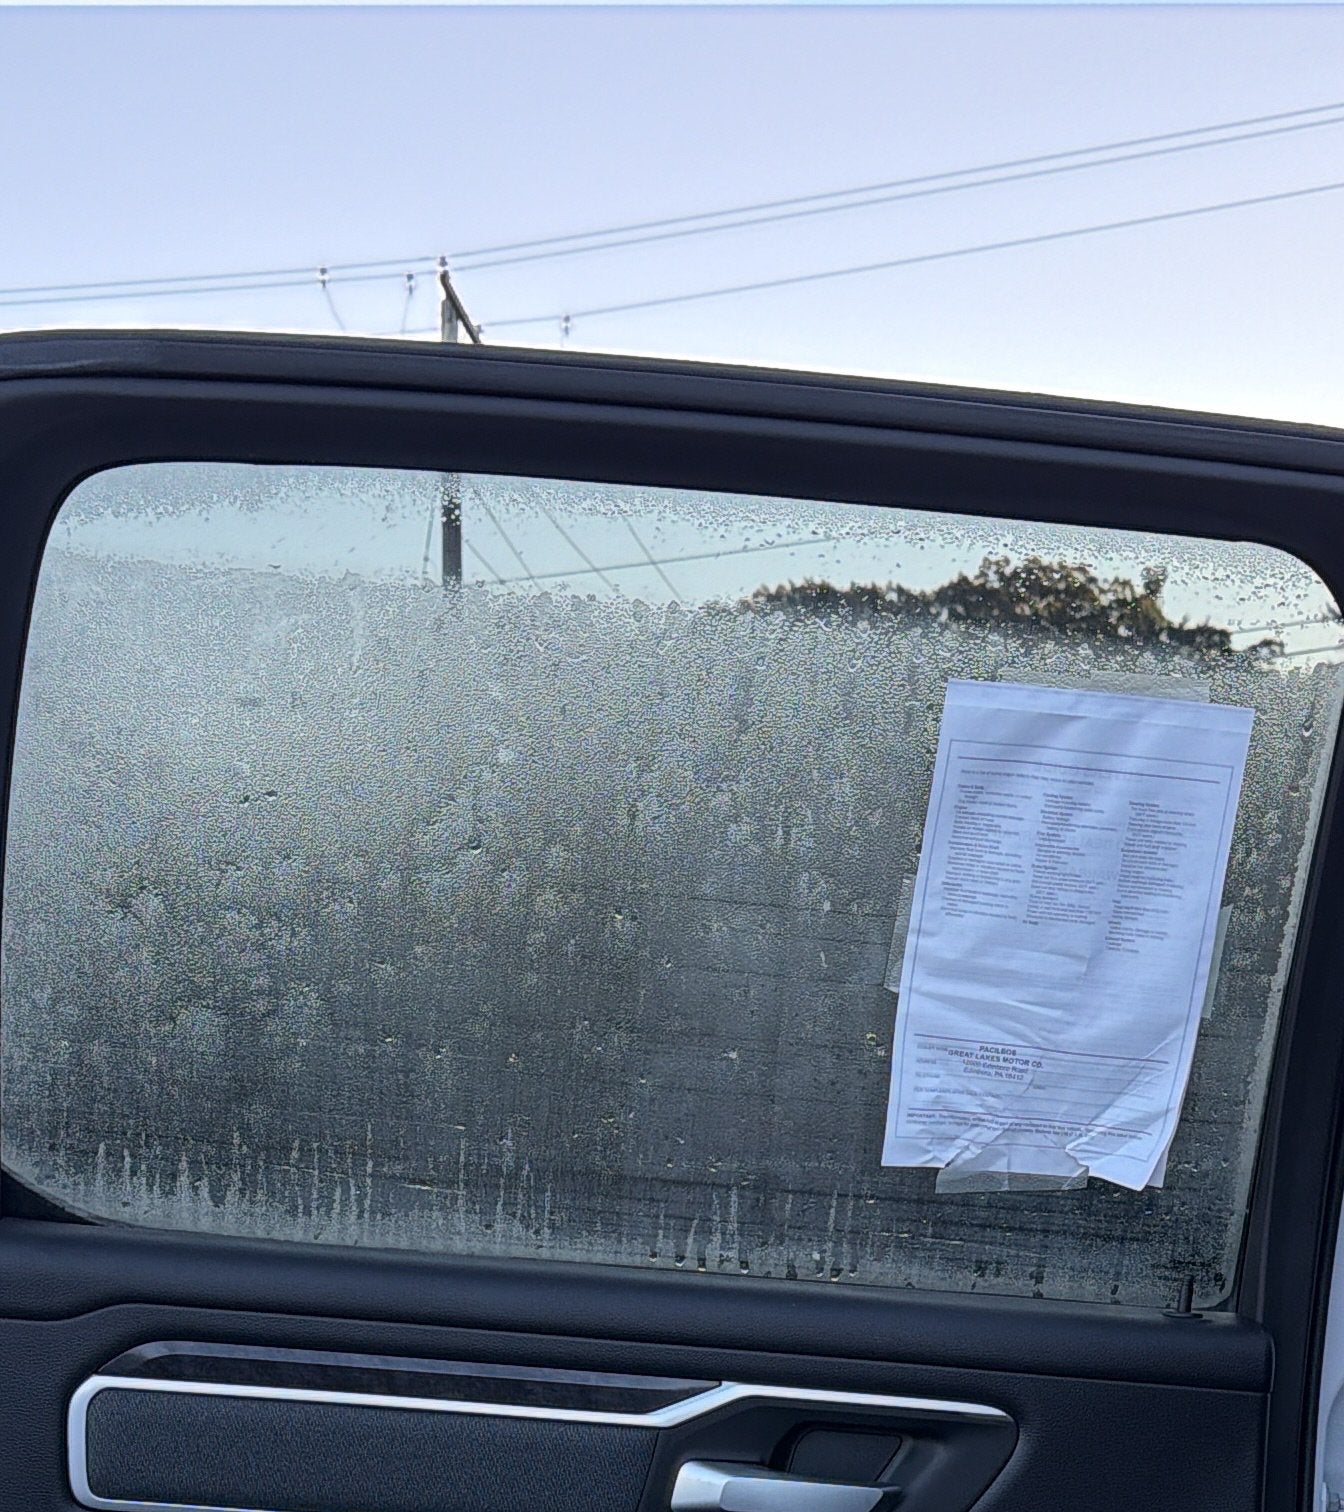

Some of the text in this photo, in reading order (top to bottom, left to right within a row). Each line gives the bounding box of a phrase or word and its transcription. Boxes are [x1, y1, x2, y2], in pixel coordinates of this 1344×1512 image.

[948, 1049, 974, 1059] GREAT
[975, 1053, 1001, 1062] LAKES
[1002, 1056, 1030, 1066] MOTOR
